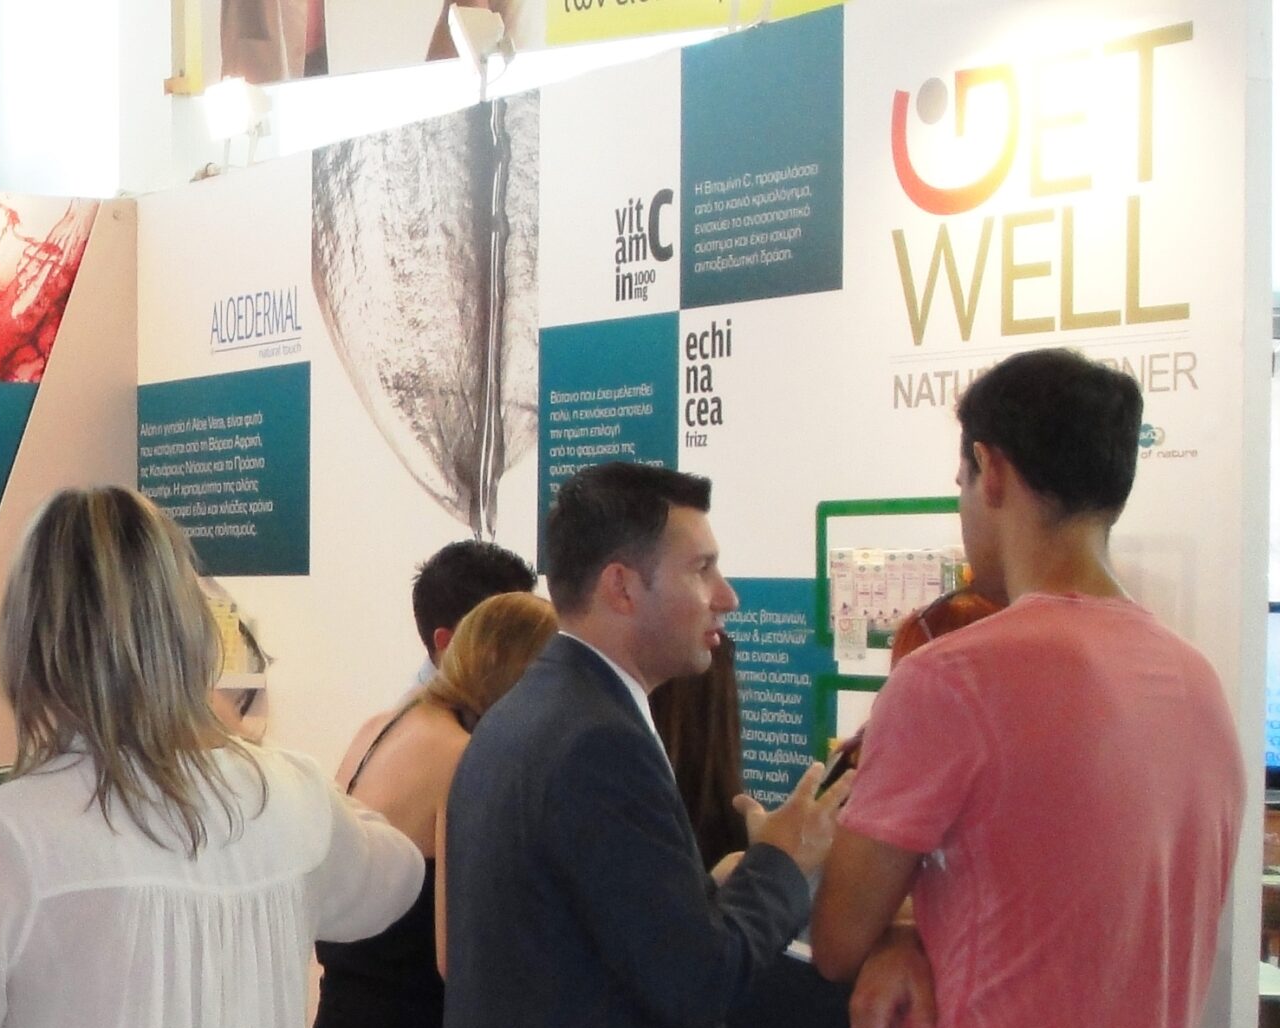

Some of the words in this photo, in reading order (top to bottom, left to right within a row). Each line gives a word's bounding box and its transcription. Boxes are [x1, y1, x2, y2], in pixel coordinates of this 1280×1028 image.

[891, 20, 1193, 216] GET
[615, 198, 643, 235] vit
[615, 233, 647, 264] am
[615, 266, 633, 302] in
[634, 269, 656, 286] 1000
[891, 195, 1190, 346] WELL
[634, 285, 648, 301] mg
[210, 285, 302, 345] ALOEDERMAL
[685, 319, 732, 361] echi
[686, 363, 713, 394] na
[685, 397, 723, 428] cea
[685, 431, 708, 448] frizz
[1141, 450, 1152, 459] of
[1157, 449, 1198, 459] nature
